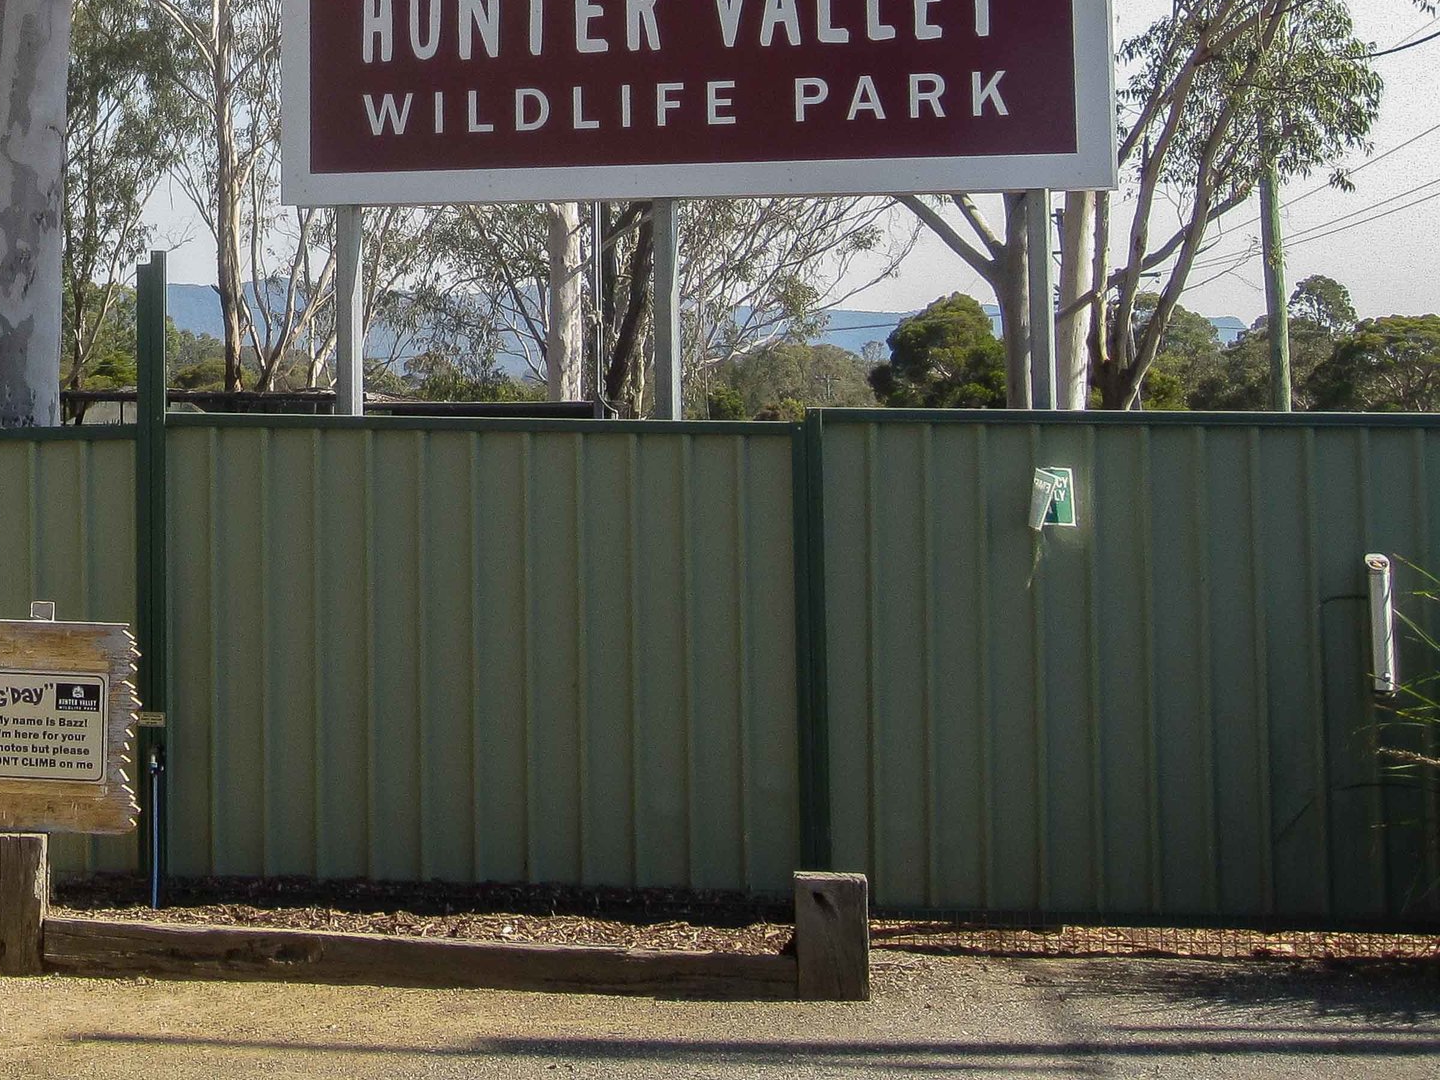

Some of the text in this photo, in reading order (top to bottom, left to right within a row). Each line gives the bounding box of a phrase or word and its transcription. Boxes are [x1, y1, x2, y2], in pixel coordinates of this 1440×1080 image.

[362, 70, 1009, 136] WILDLIFE PARK
[12, 717, 43, 726] name
[46, 717, 56, 726] is
[14, 730, 39, 739] here
[42, 731, 59, 740] for
[61, 733, 86, 742] your
[31, 744, 50, 753] but
[52, 745, 90, 755] please
[21, 757, 56, 767] CLIMB
[59, 761, 73, 769] on
[76, 761, 93, 769] me
